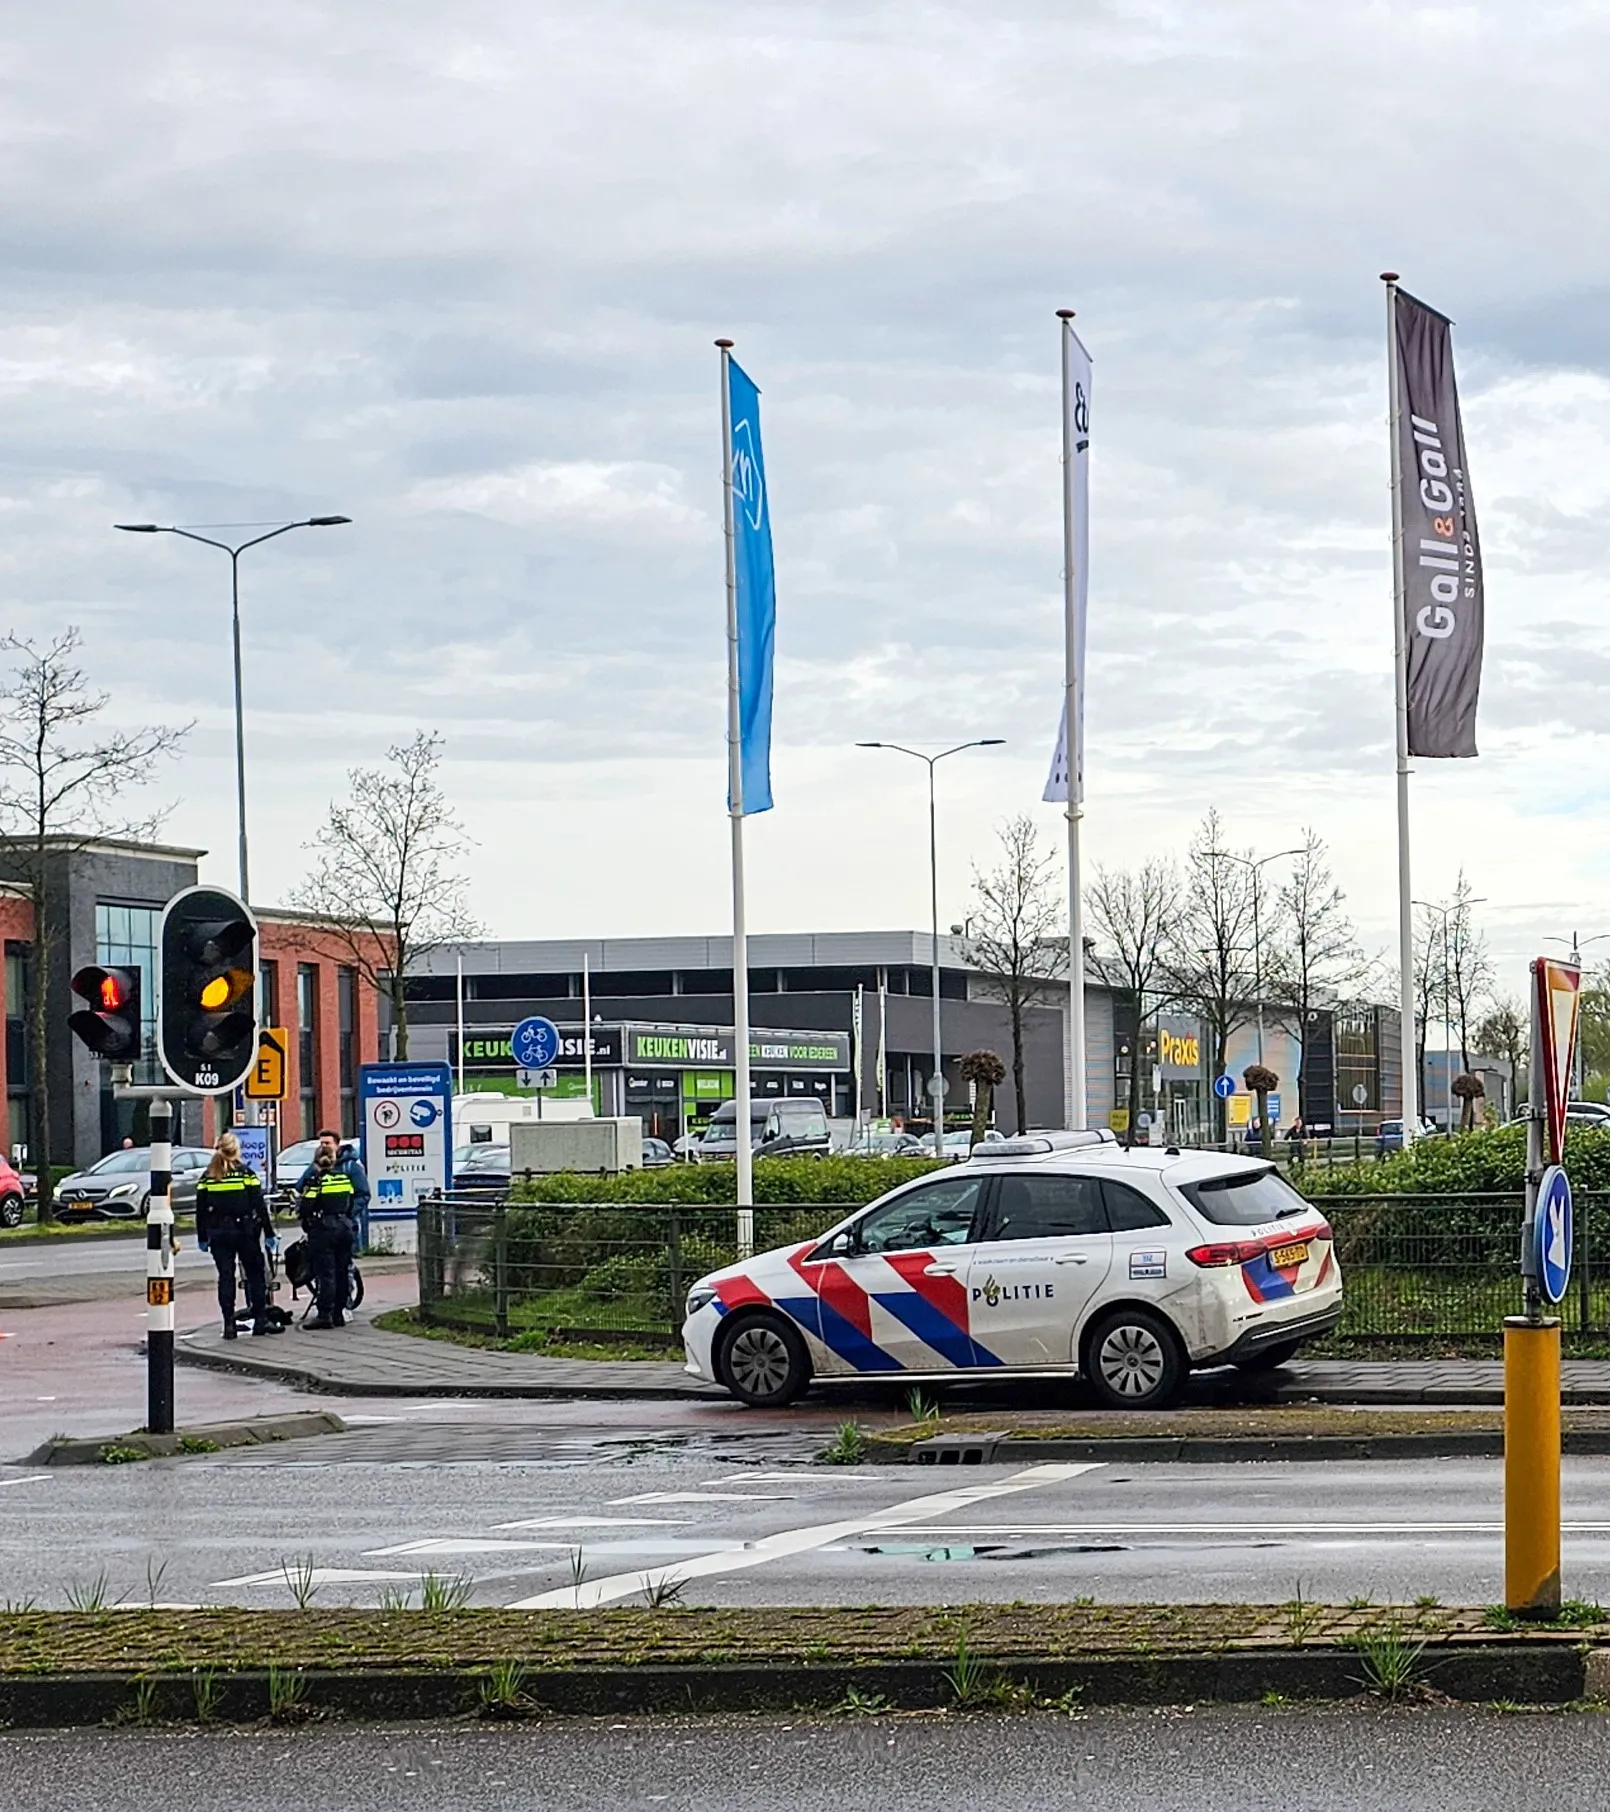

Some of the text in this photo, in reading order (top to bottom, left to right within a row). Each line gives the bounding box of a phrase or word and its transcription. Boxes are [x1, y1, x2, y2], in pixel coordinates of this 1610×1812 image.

[1411, 413, 1459, 639] Gall & Gall
[462, 1038, 611, 1058] KEUKISIE.nl
[1160, 1029, 1199, 1066] Praxis
[195, 1072, 219, 1086] K09
[257, 1059, 271, 1084] E
[386, 1163, 426, 1174] POLITIE
[973, 1284, 1054, 1307] POLITIE
